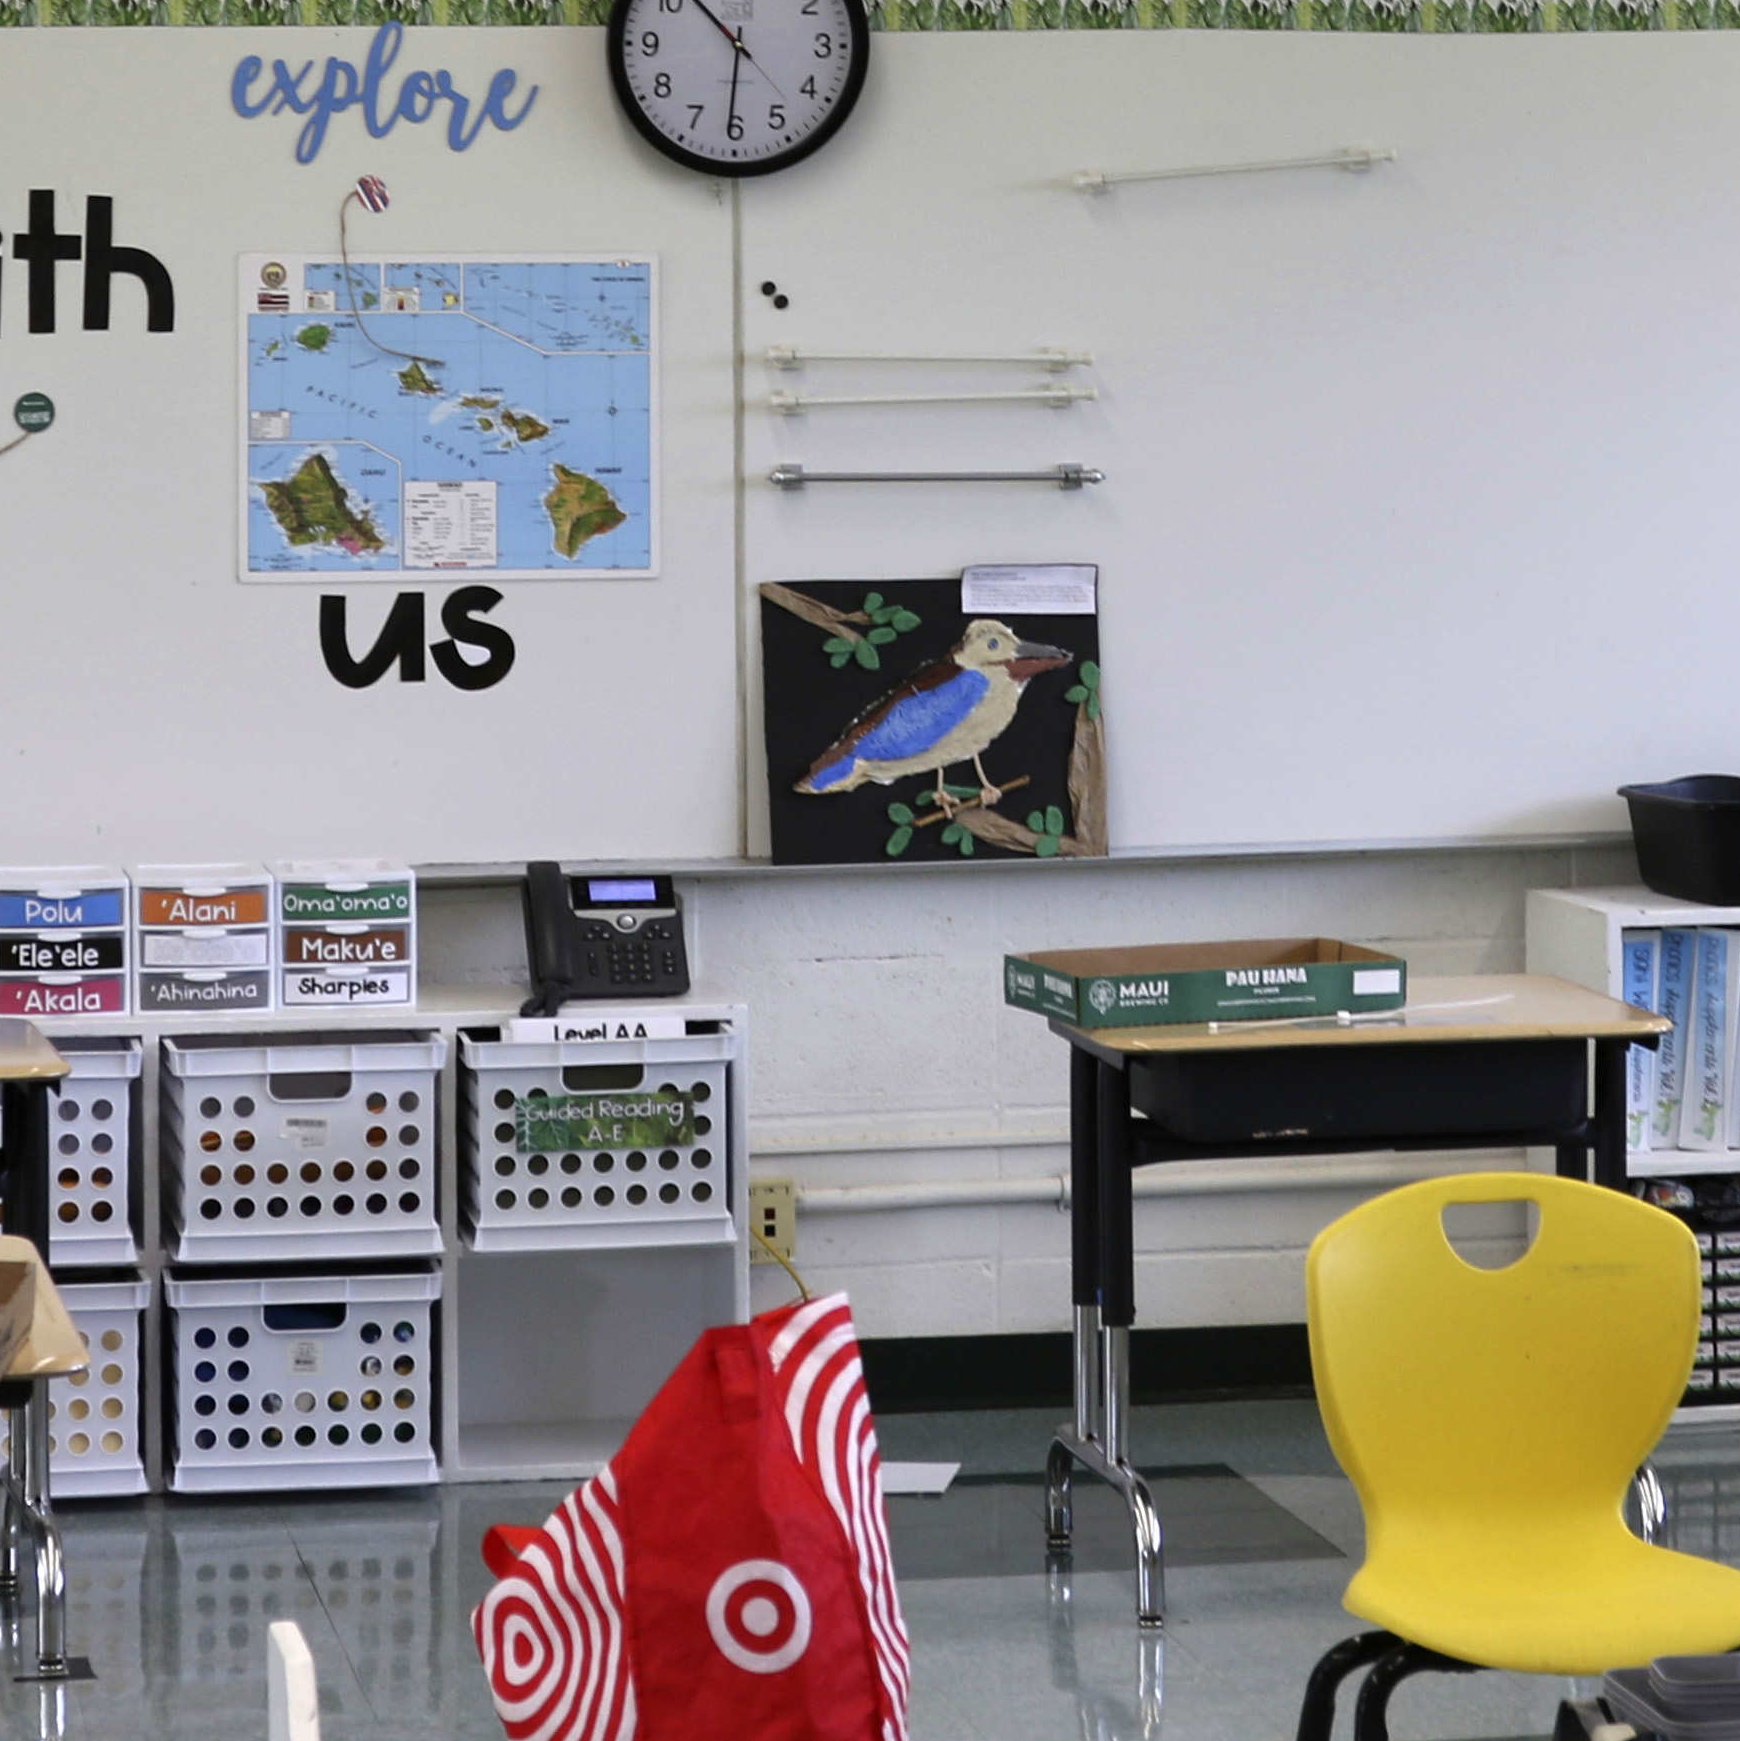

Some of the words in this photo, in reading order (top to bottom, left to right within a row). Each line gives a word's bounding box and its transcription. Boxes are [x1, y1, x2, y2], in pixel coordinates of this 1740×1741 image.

[642, 32, 658, 57] 9
[814, 33, 831, 59] 3
[229, 21, 538, 165] explore
[654, 72, 672, 98] 8
[800, 75, 817, 100] 4
[687, 105, 704, 130] 7
[727, 115, 744, 140] 6
[768, 105, 786, 130] 5
[306, 385, 377, 420] PACIFIC
[319, 585, 517, 691] us
[25, 900, 82, 924] Polu
[298, 977, 389, 1000] Sharpies
[1119, 980, 1169, 998] MAUI
[1226, 969, 1261, 987] PAU
[526, 1104, 594, 1121] Guided
[599, 1099, 684, 1126] Reading
[588, 1124, 623, 1142] A-E
